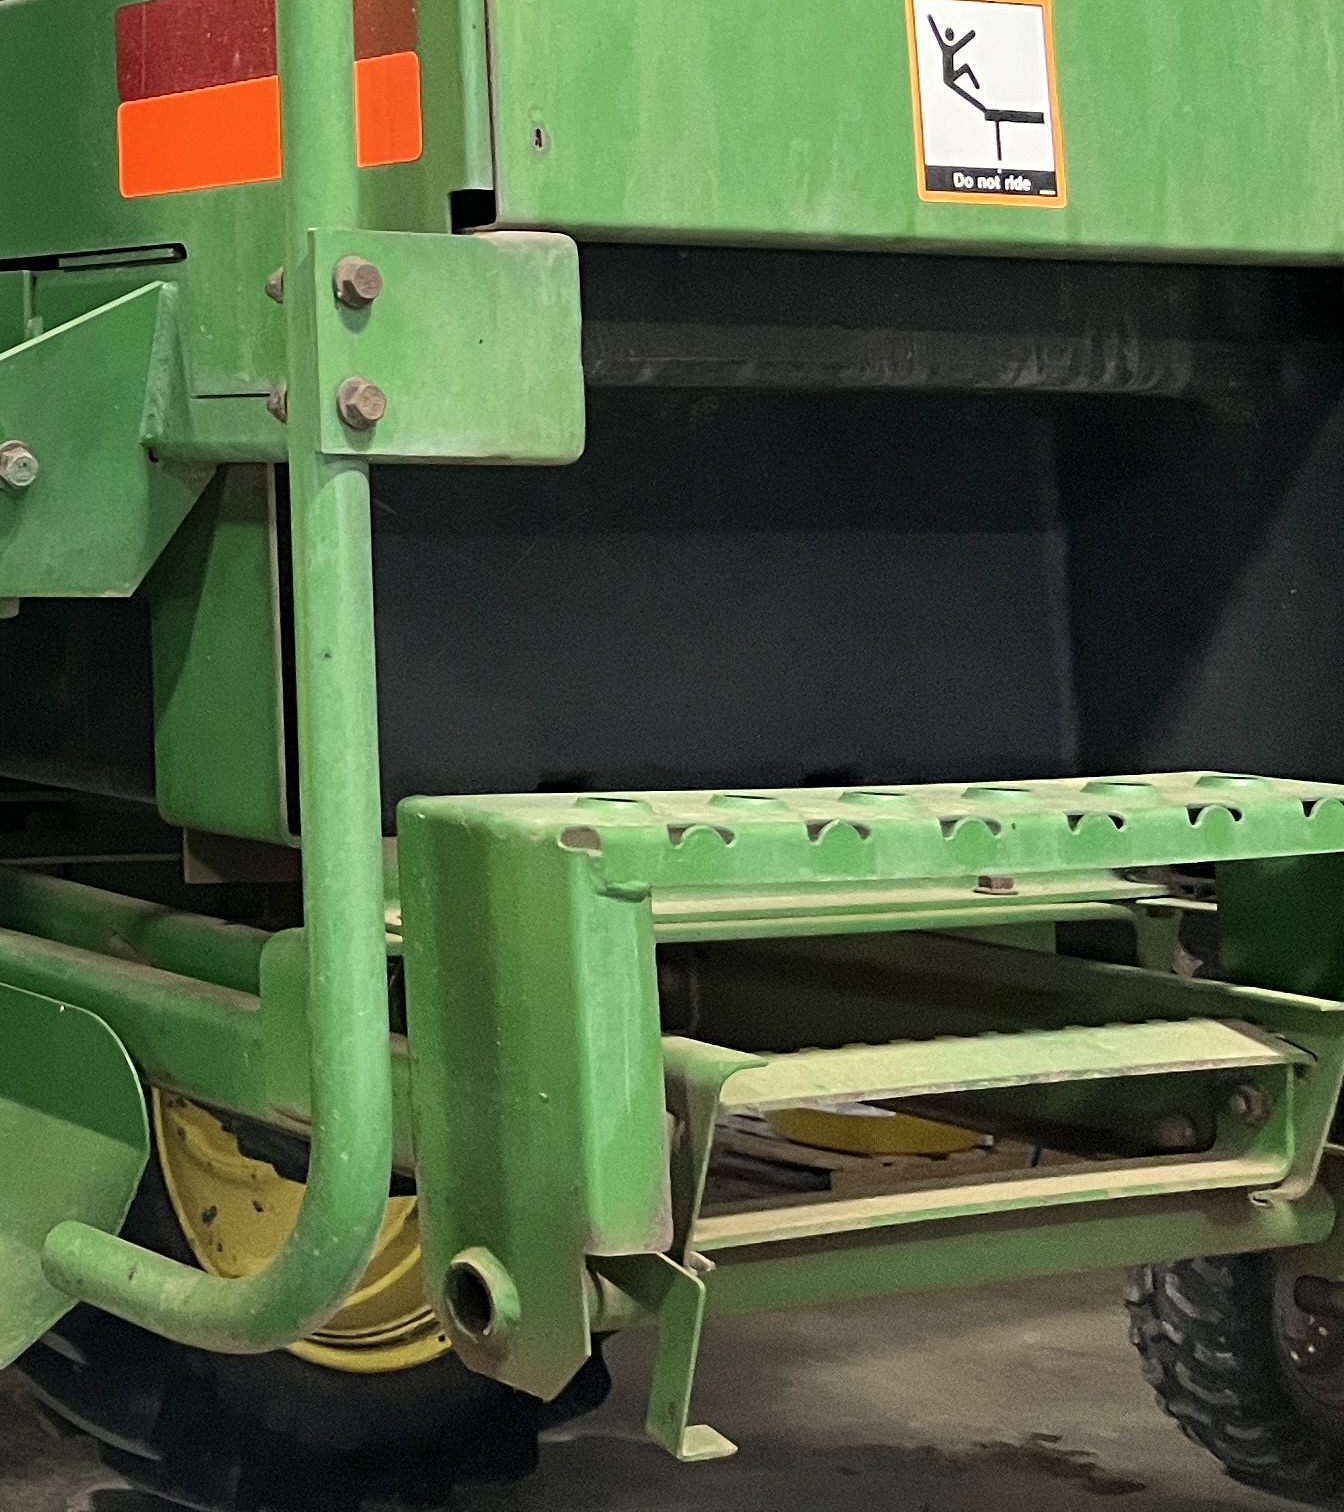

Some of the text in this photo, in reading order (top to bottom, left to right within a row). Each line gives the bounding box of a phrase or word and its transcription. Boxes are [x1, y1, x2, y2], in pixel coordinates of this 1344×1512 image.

[953, 172, 1032, 191] Do not ride
